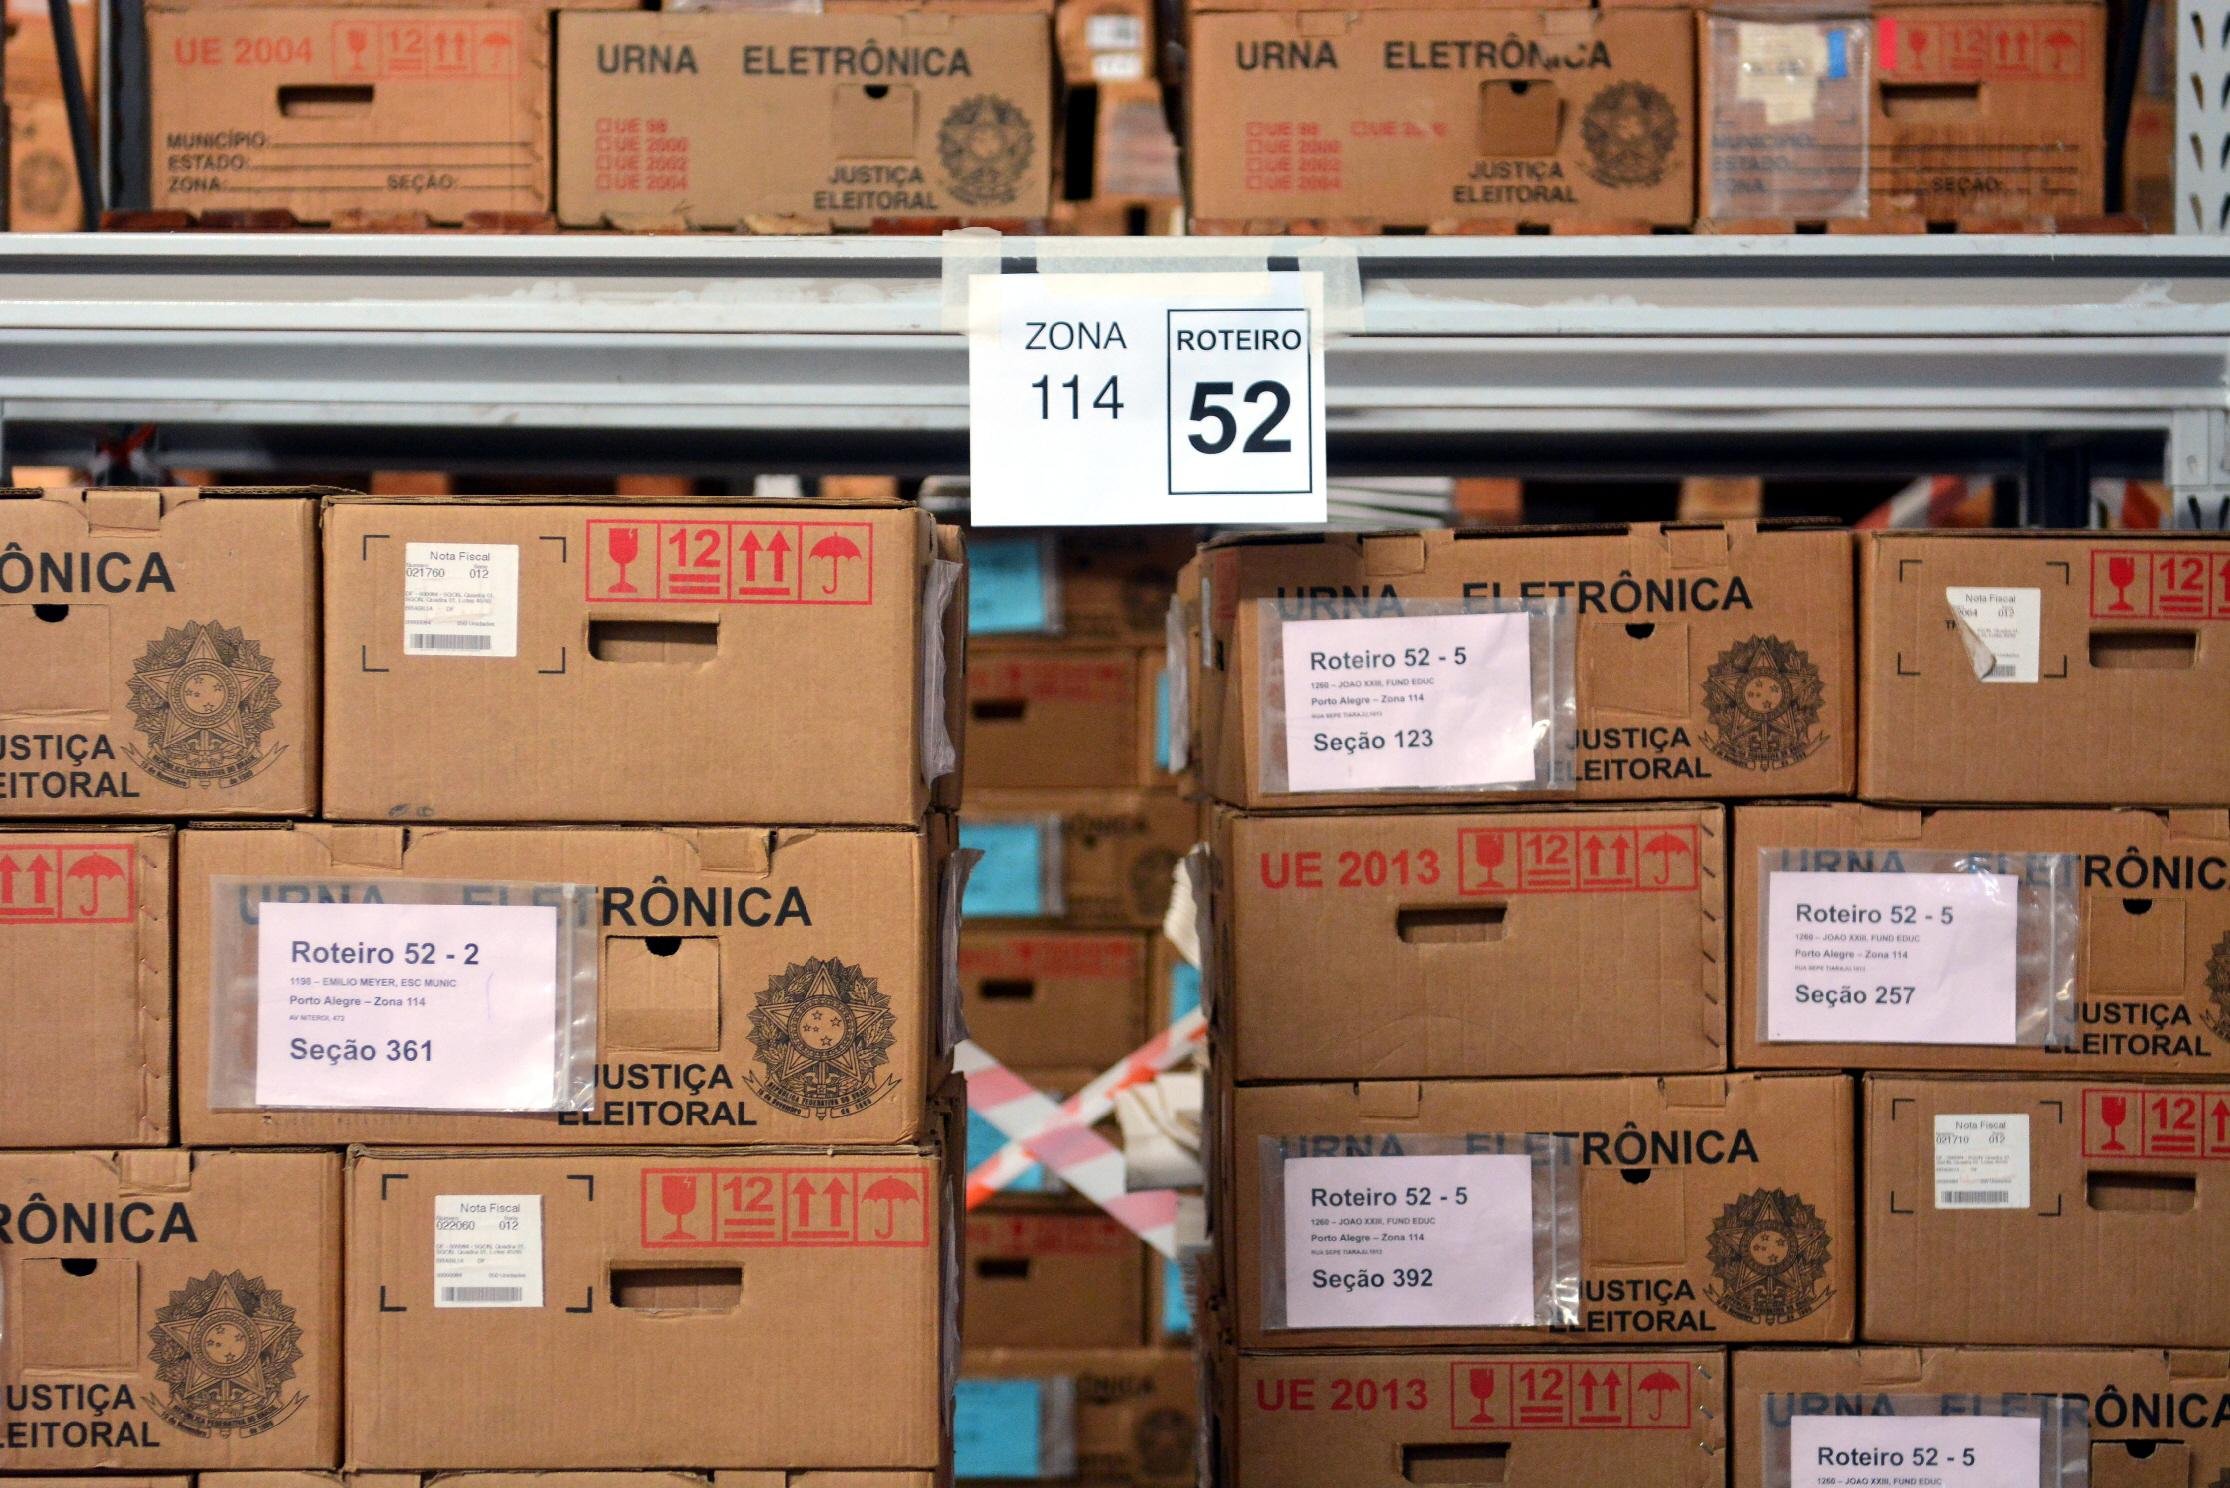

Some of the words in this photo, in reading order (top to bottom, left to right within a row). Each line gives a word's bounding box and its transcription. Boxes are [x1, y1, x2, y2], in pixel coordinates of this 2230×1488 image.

[174, 37, 223, 68] UE
[234, 36, 314, 65] 2004
[390, 29, 422, 54] 12
[1952, 29, 1984, 54] 12
[597, 44, 699, 75] URNA
[743, 38, 972, 77] ELETRÔNICA
[1236, 41, 1338, 71] URNA
[828, 166, 924, 187] JUSTIÇA
[1469, 161, 1563, 182] JUSTIÇA
[814, 191, 937, 211] ELEITORAL
[1453, 185, 1578, 206] ELEITORAL
[1025, 321, 1127, 350] ZONA
[1177, 329, 1302, 351] ROTEIRO
[1032, 374, 1124, 419] 114
[1188, 380, 1292, 454] 52
[430, 551, 456, 561] Nota
[459, 552, 491, 561] Fiscal
[668, 528, 721, 568] 12
[406, 568, 445, 578] 021760
[470, 569, 489, 578] 012
[2160, 558, 2204, 590] 12
[1278, 585, 1402, 620] URNA
[1966, 594, 1986, 603] Nota
[1990, 594, 2016, 603] Fiscal
[1311, 650, 1395, 671] Roteiro
[1405, 648, 1429, 667] 52
[1454, 647, 1466, 665] 5
[1338, 680, 1361, 688] JOAO
[1412, 678, 1434, 686] EDUC
[1312, 697, 1337, 706] Porto
[1340, 696, 1370, 706] Alegre
[1381, 695, 1405, 703] Zona
[1409, 694, 1424, 702] 114
[1314, 732, 1385, 754] Seção
[1395, 729, 1433, 748] 123
[1528, 834, 1569, 866] 12
[1260, 852, 1323, 888] UE
[1338, 849, 1441, 888] 2013
[1796, 904, 1882, 923] Roteiro
[1891, 905, 1917, 924] 52
[1941, 906, 1953, 925] 5
[292, 940, 394, 964] Roteiro
[405, 942, 435, 965] 52
[464, 943, 479, 965] 2
[1823, 950, 1854, 960] Alegre
[1865, 951, 1889, 959] Zona
[1893, 951, 1908, 959] 114
[323, 977, 357, 986] EMILIO
[360, 978, 398, 988] MEYER,
[401, 979, 421, 987] ESC
[425, 979, 457, 987] MUNIC
[289, 995, 320, 1005] Porto
[324, 996, 361, 1007] Alegre
[374, 997, 403, 1006] Zona
[408, 997, 426, 1006] 114
[1795, 985, 1867, 1008] Seção
[1875, 986, 1916, 1004] 257
[290, 1037, 376, 1066] Seção
[387, 1039, 432, 1061] 361
[1980, 1121, 2006, 1129] Fiscal
[2152, 1099, 2196, 1130] 12
[1989, 1136, 2005, 1144] 012
[723, 1176, 774, 1212] 12
[1311, 1188, 1397, 1207] Roteiro
[1406, 1187, 1431, 1206] 52
[1456, 1187, 1468, 1205] 5
[460, 1203, 486, 1213] Nota
[490, 1203, 520, 1213] Fiscal
[436, 1221, 475, 1231] 022060
[499, 1221, 519, 1231] 012
[1413, 1217, 1436, 1225] EDUC
[1340, 1234, 1370, 1244] Alegre
[1409, 1233, 1424, 1241] 114
[1313, 1268, 1384, 1292] Seção
[1393, 1268, 1433, 1287] 392
[1257, 1380, 1315, 1412] UE
[1331, 1378, 1428, 1411] 2013
[1520, 1369, 1563, 1402] 12
[1818, 1447, 1903, 1466] Roteiro
[1913, 1448, 1938, 1466] 52
[1962, 1448, 1975, 1466] 5
